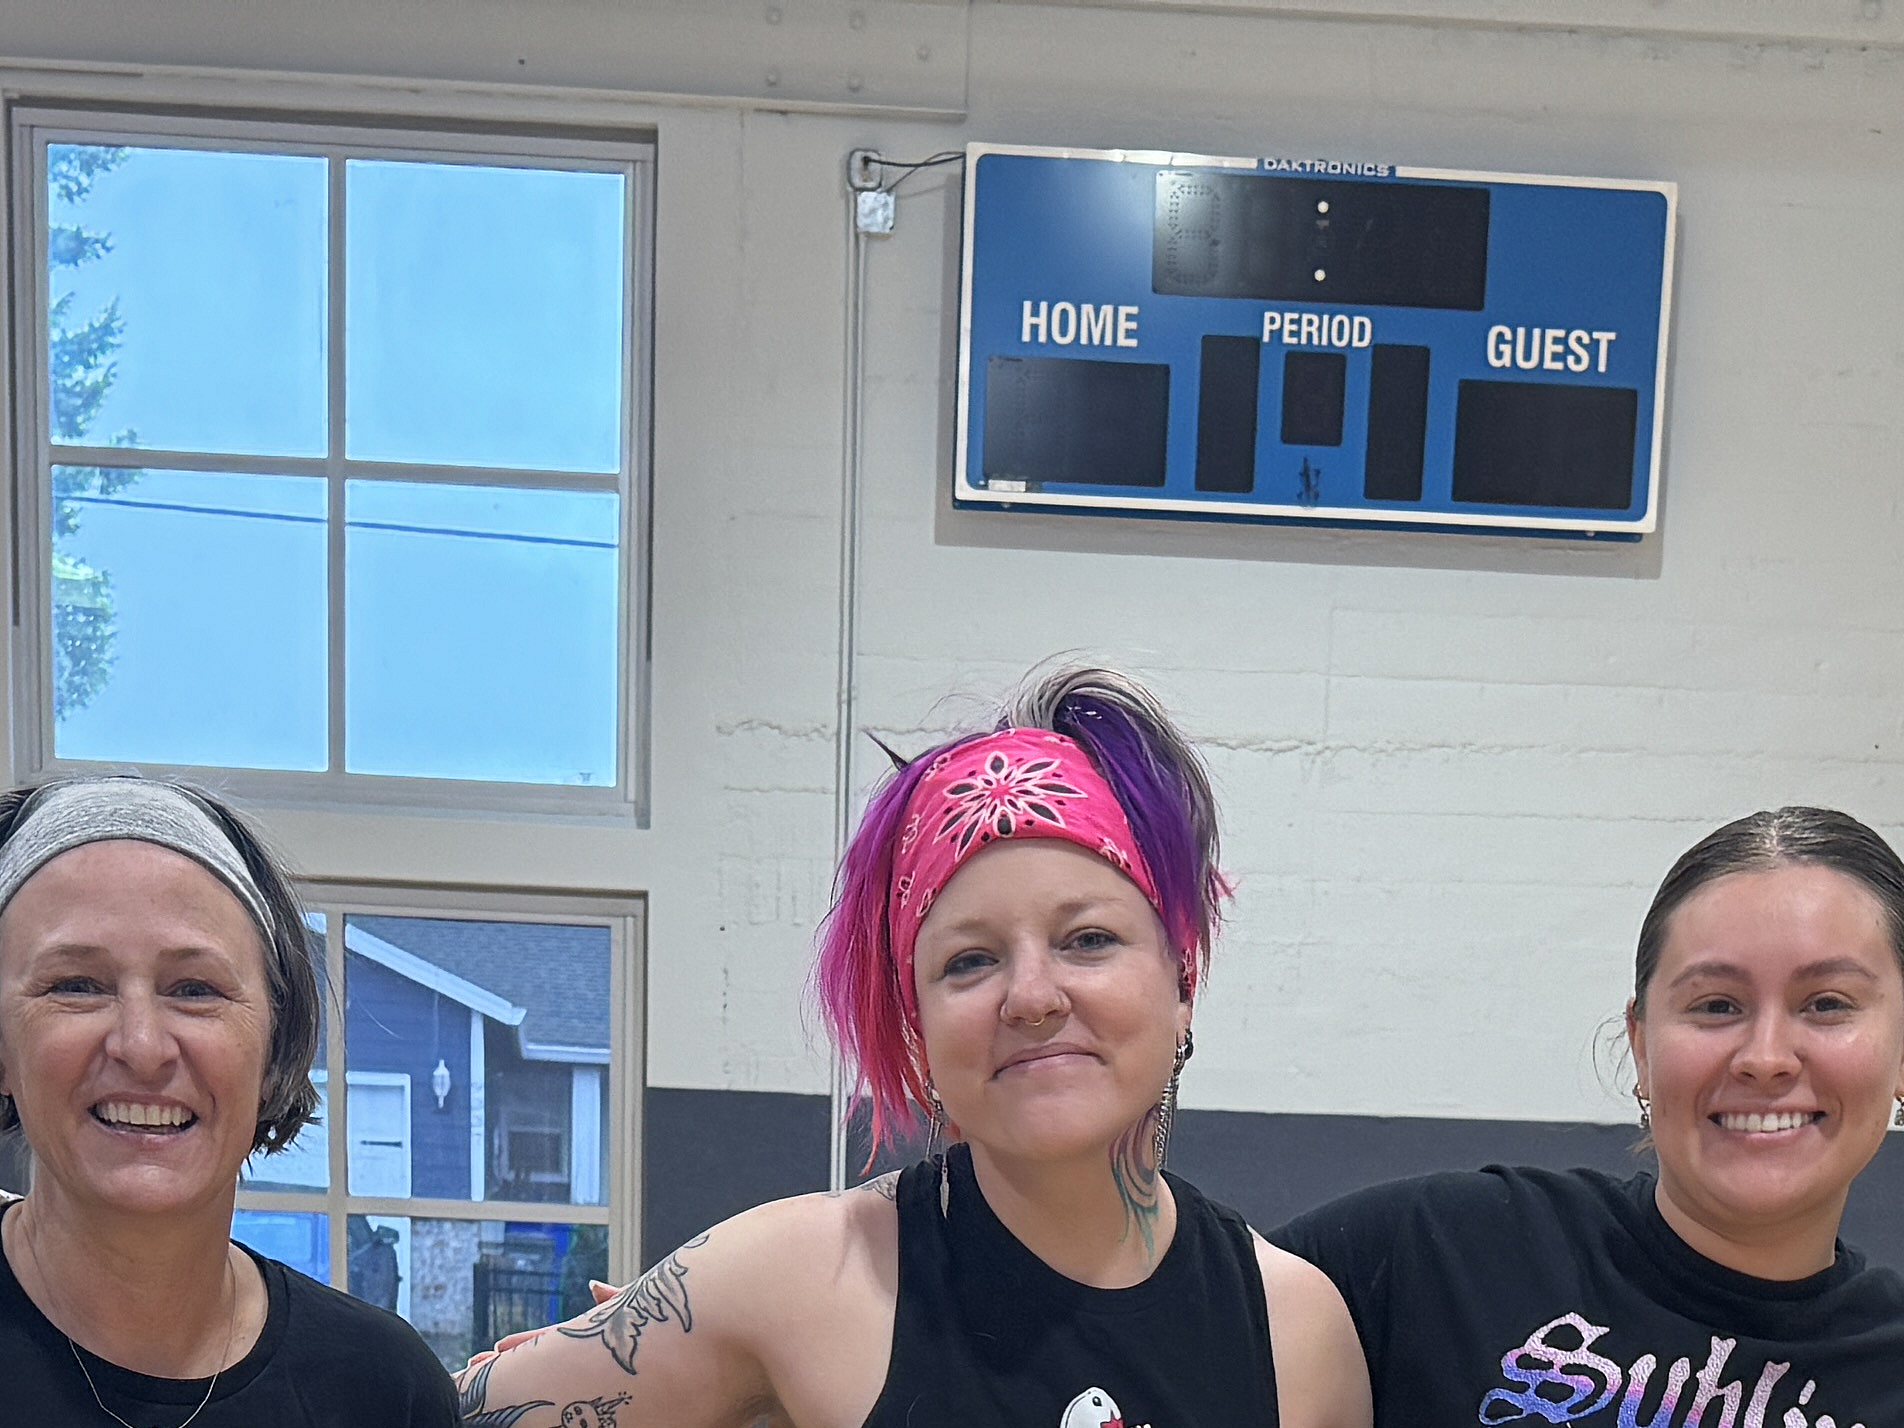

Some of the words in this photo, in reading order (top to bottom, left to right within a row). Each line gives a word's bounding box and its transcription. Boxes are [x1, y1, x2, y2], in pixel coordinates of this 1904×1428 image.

[1263, 157, 1391, 177] DAKTRONICS
[1021, 300, 1140, 348] HOME
[1262, 311, 1373, 349] PERIOD
[1486, 326, 1617, 374] GUEST
